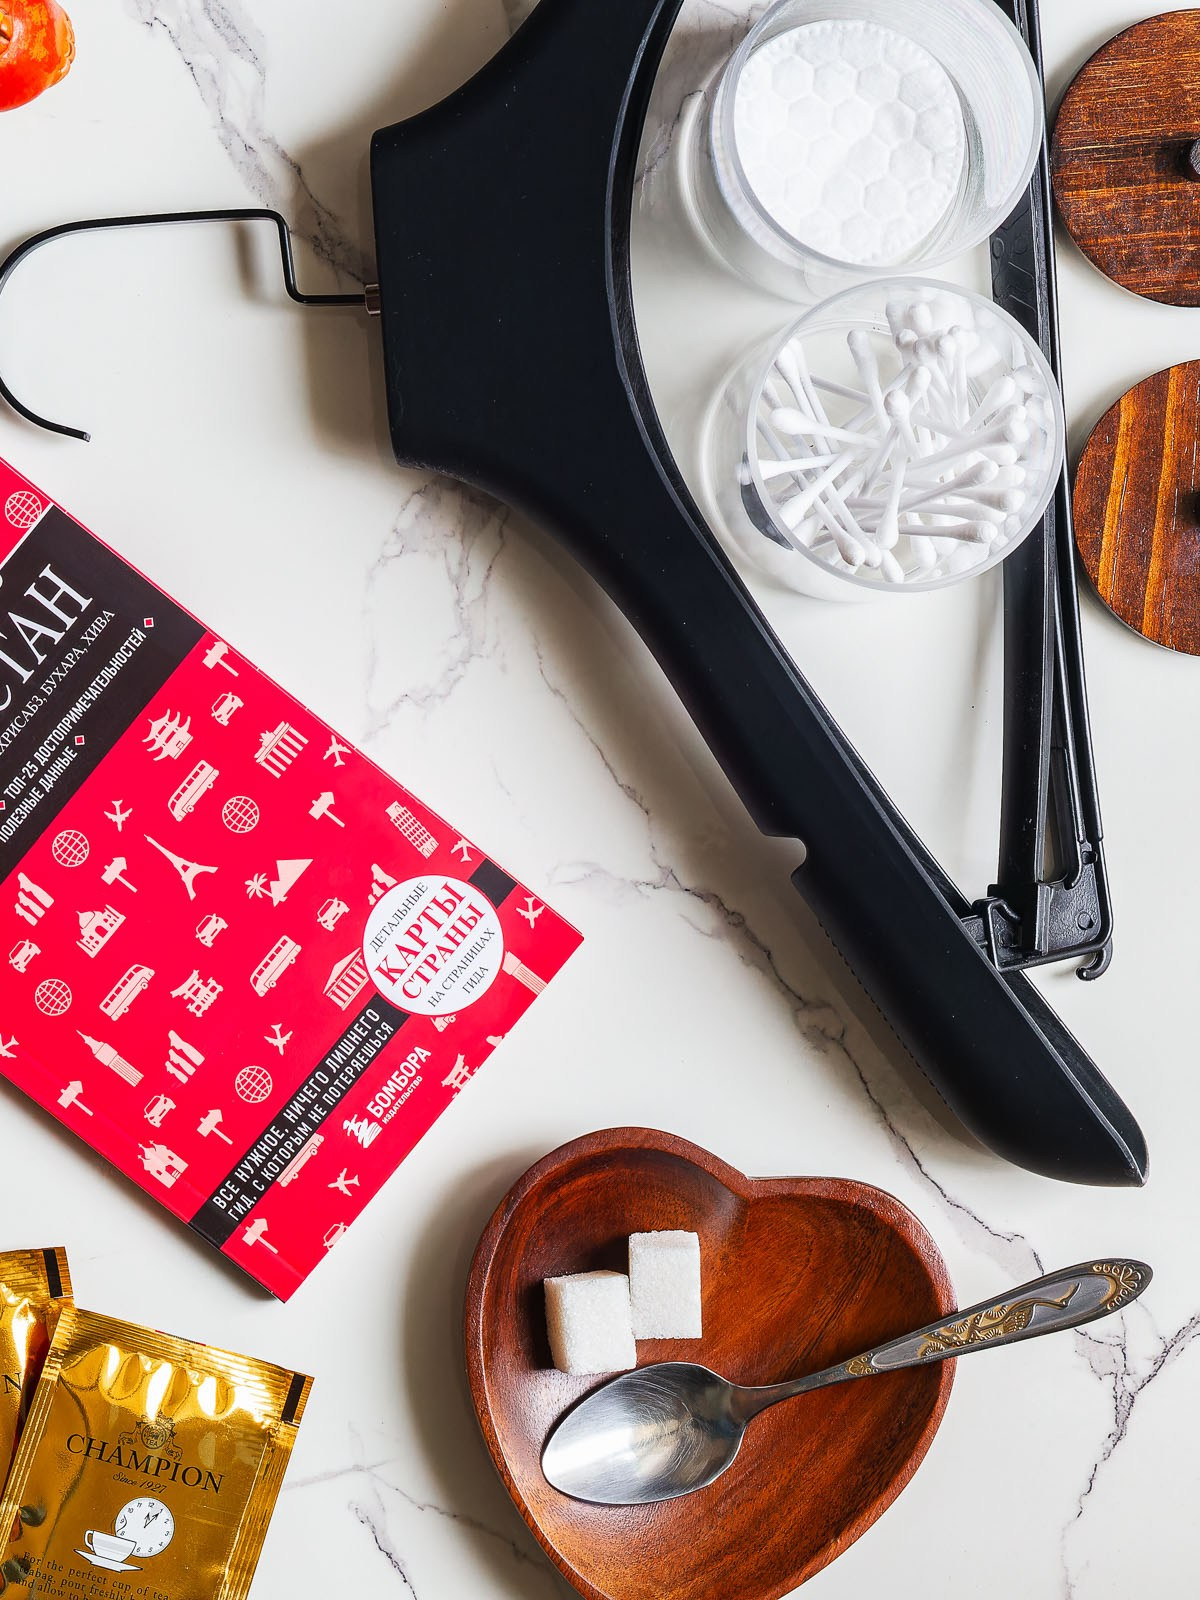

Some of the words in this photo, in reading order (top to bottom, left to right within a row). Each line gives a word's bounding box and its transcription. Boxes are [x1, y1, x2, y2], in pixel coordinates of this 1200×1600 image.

[40, 646, 88, 695] БУХАРА,
[80, 610, 116, 646] ХИВА
[3, 760, 39, 800] ТОП-25
[33, 627, 147, 767] ДОСТОПРИМЕЧАТЕЛЬНОСТЕЙ
[38, 745, 78, 793] ДАННЫЕ
[369, 881, 429, 954] ДЕТАЛЬНЫЕ
[374, 882, 466, 987] КАРТЫ
[402, 902, 486, 999] СТРАНЫ
[427, 990, 445, 1008] НА
[441, 928, 495, 990] СТРАНИЦАХ
[462, 966, 489, 994] ГИДА
[212, 1180, 241, 1209] ВСЕ
[234, 1125, 288, 1183] НУЖНОЕ,
[282, 1070, 330, 1124] НИЧЕГО
[325, 1007, 380, 1073] ЛИШНЕГО
[366, 1046, 432, 1119] БОМБОРА
[381, 1075, 423, 1125] ИЗДАТЕЛЬСТВО
[227, 1192, 257, 1222] ГИД,
[253, 1179, 265, 1192] С
[261, 1124, 313, 1183] КОТОРЫМ
[307, 1103, 328, 1124] НЕ
[322, 1021, 394, 1106] ПОТЕРЯЕШЬСЯ
[66, 1433, 225, 1494] CHAMPION
[112, 1471, 138, 1486] Since
[139, 1479, 168, 1494] 1927
[15, 1577, 35, 1590] and
[37, 1581, 66, 1598] allow
[69, 1592, 79, 1600] to
[23, 1551, 42, 1565] For
[46, 1559, 64, 1572] the
[68, 1567, 107, 1585] perfect
[112, 1580, 131, 1593] cup
[136, 1586, 150, 1596] of
[153, 1591, 169, 1600] tea
[60, 1578, 85, 1592] pour
